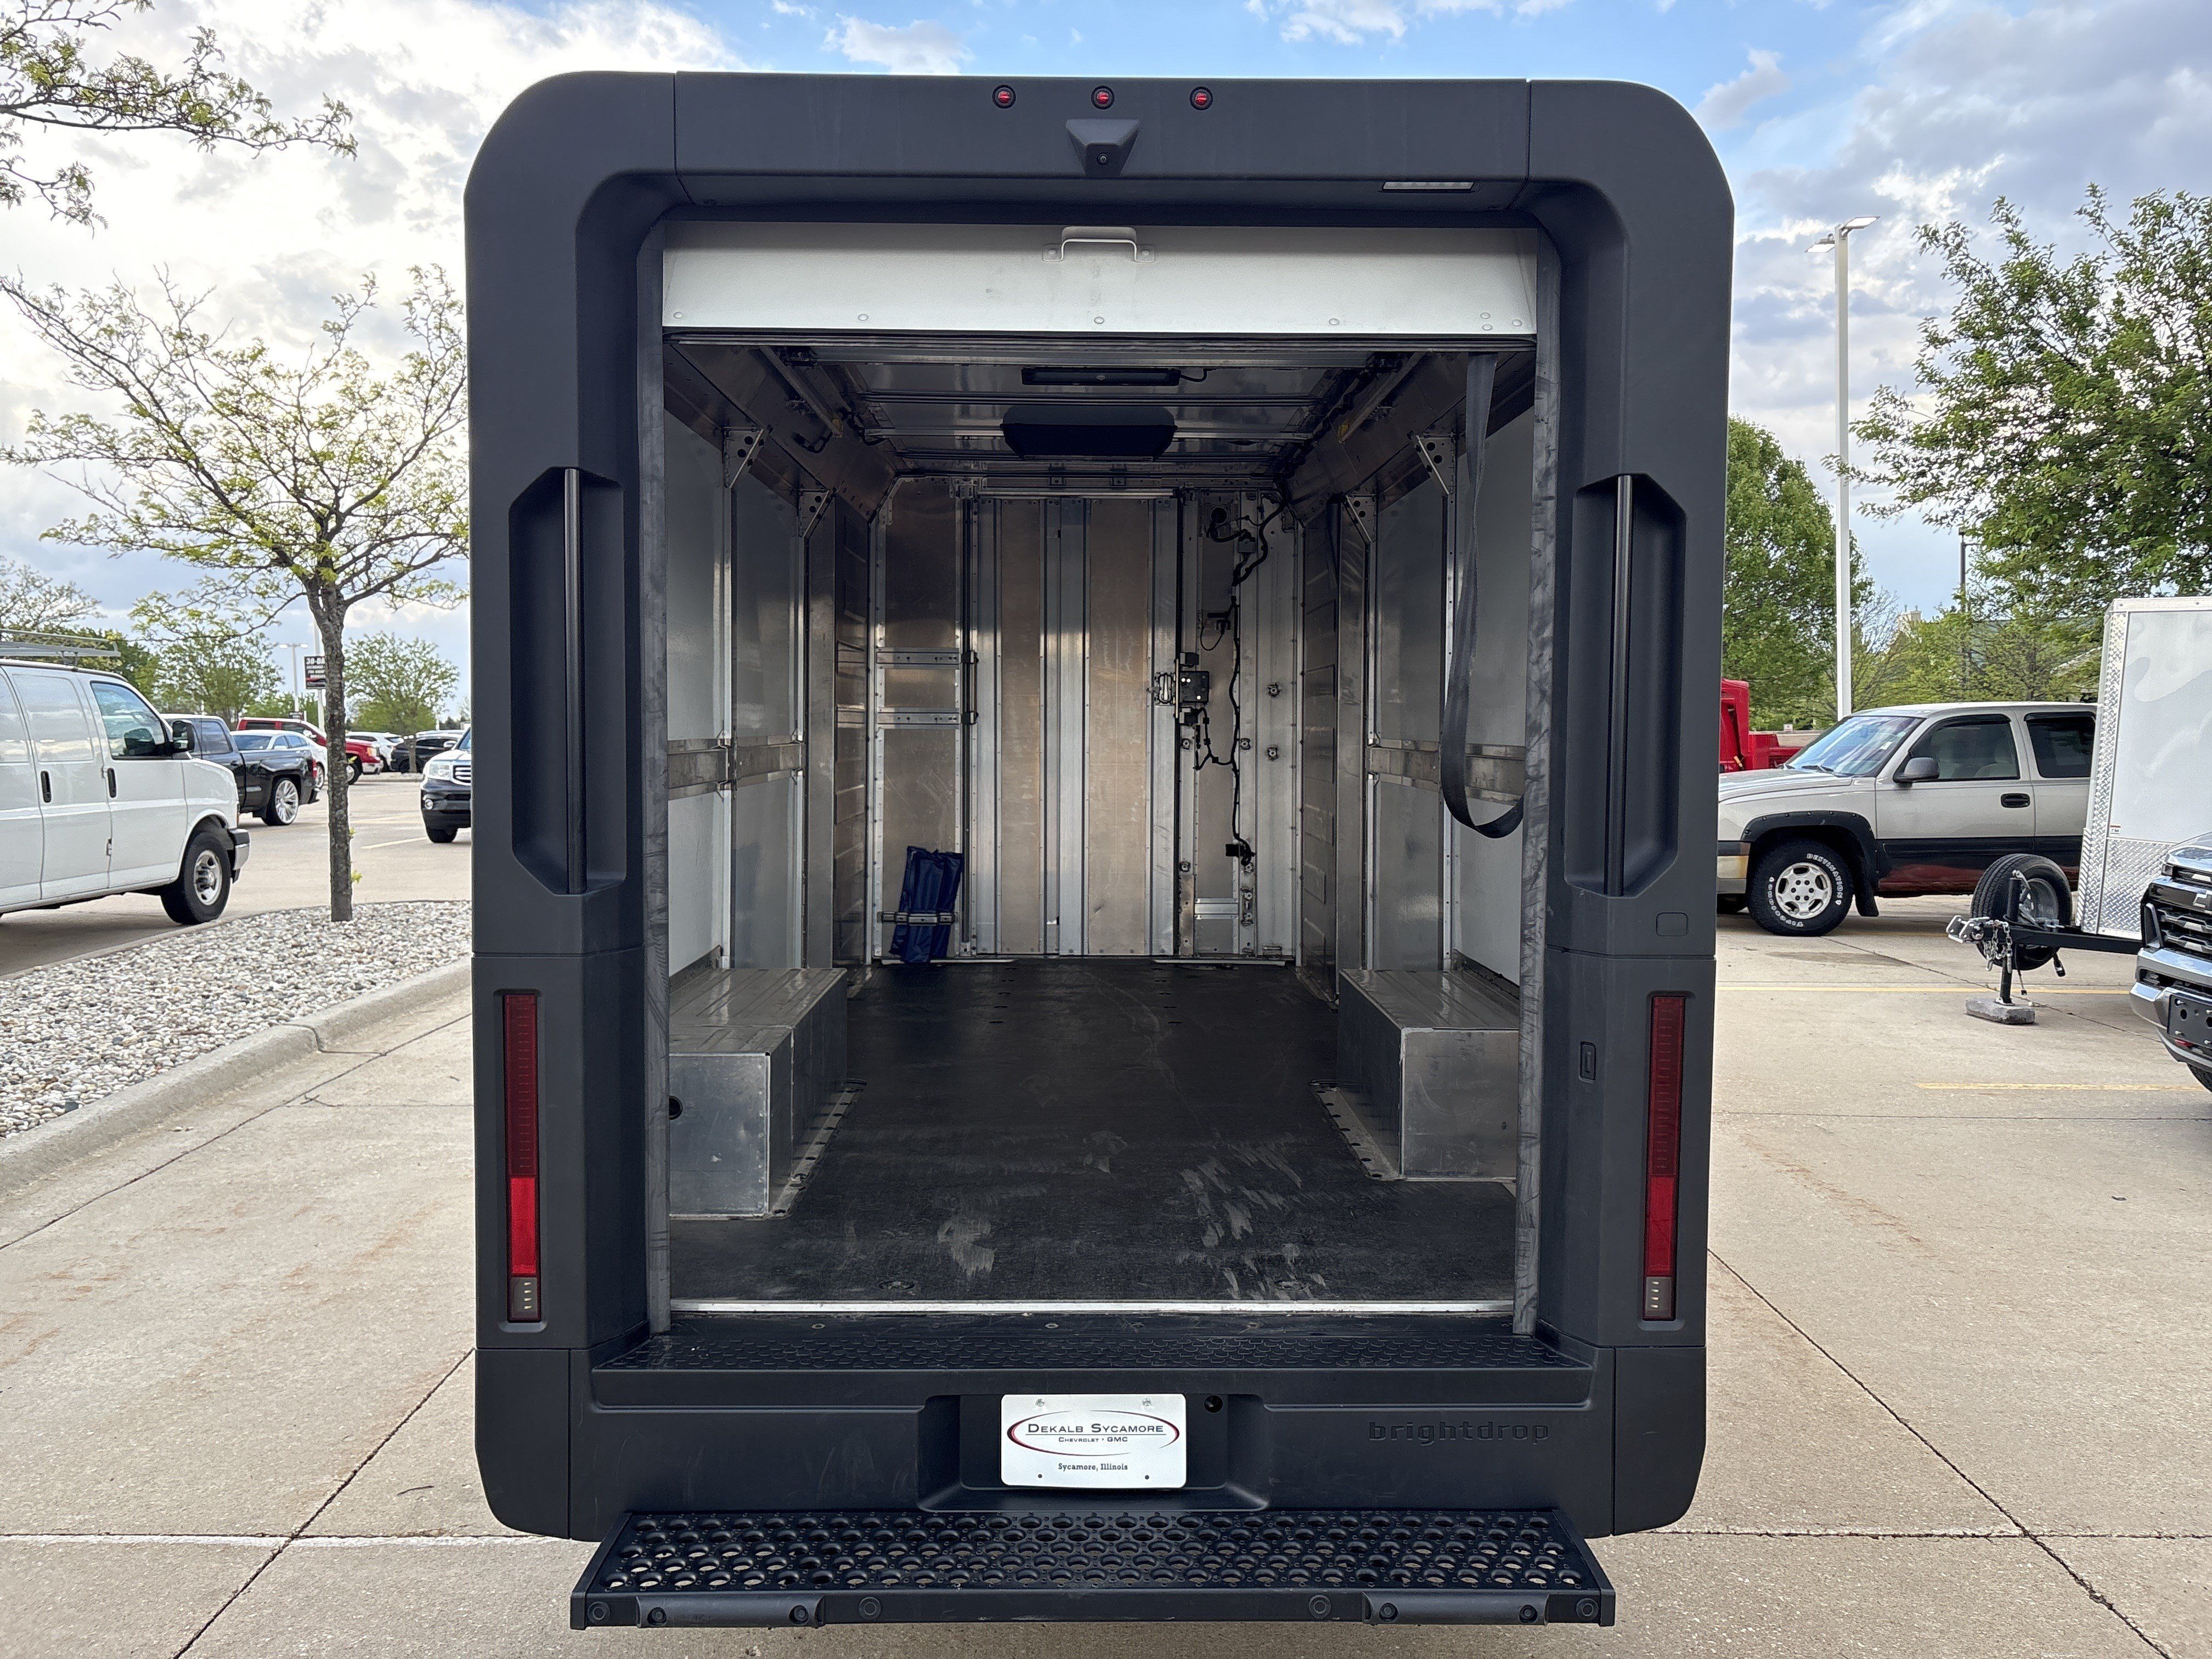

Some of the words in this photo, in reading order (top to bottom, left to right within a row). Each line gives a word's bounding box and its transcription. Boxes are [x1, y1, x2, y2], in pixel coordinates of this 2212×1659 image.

[1807, 853, 1843, 898] DESTINATION
[1028, 1423, 1084, 1433] DEKALB
[1091, 1423, 1164, 1433] SYCAMORE
[1369, 1421, 1549, 1446] brightdrop
[1058, 1463, 1098, 1471] Sycamore,
